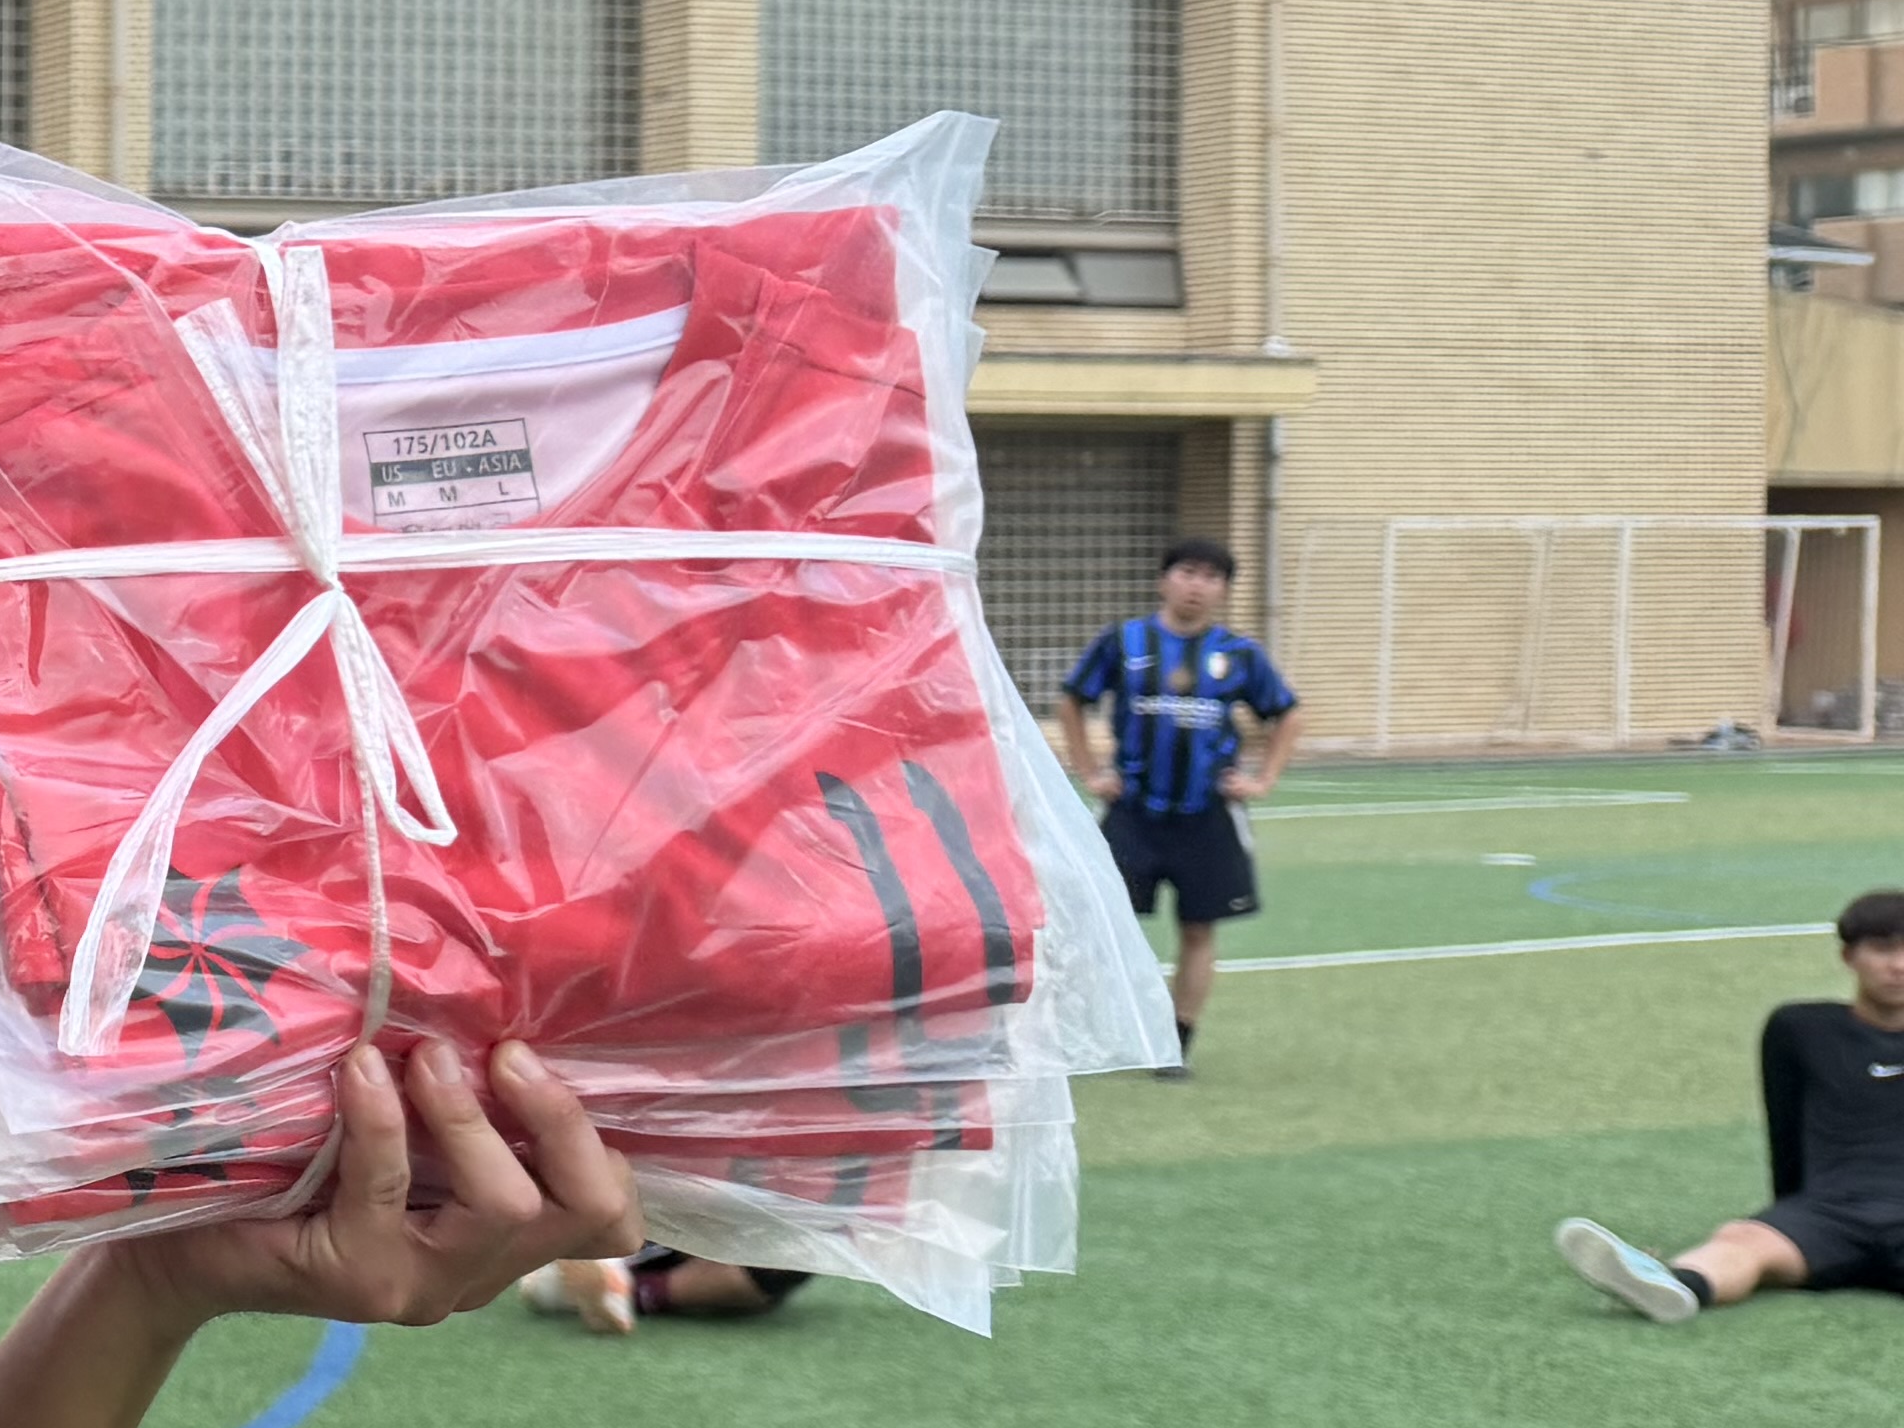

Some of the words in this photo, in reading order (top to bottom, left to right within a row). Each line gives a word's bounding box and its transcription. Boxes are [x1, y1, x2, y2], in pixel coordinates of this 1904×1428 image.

[393, 429, 498, 456] 175/102A
[382, 464, 404, 482] US
[431, 460, 457, 479] EU
[478, 452, 522, 473] ASIA
[388, 491, 406, 508] M
[439, 485, 458, 502] M
[498, 481, 509, 497] L
